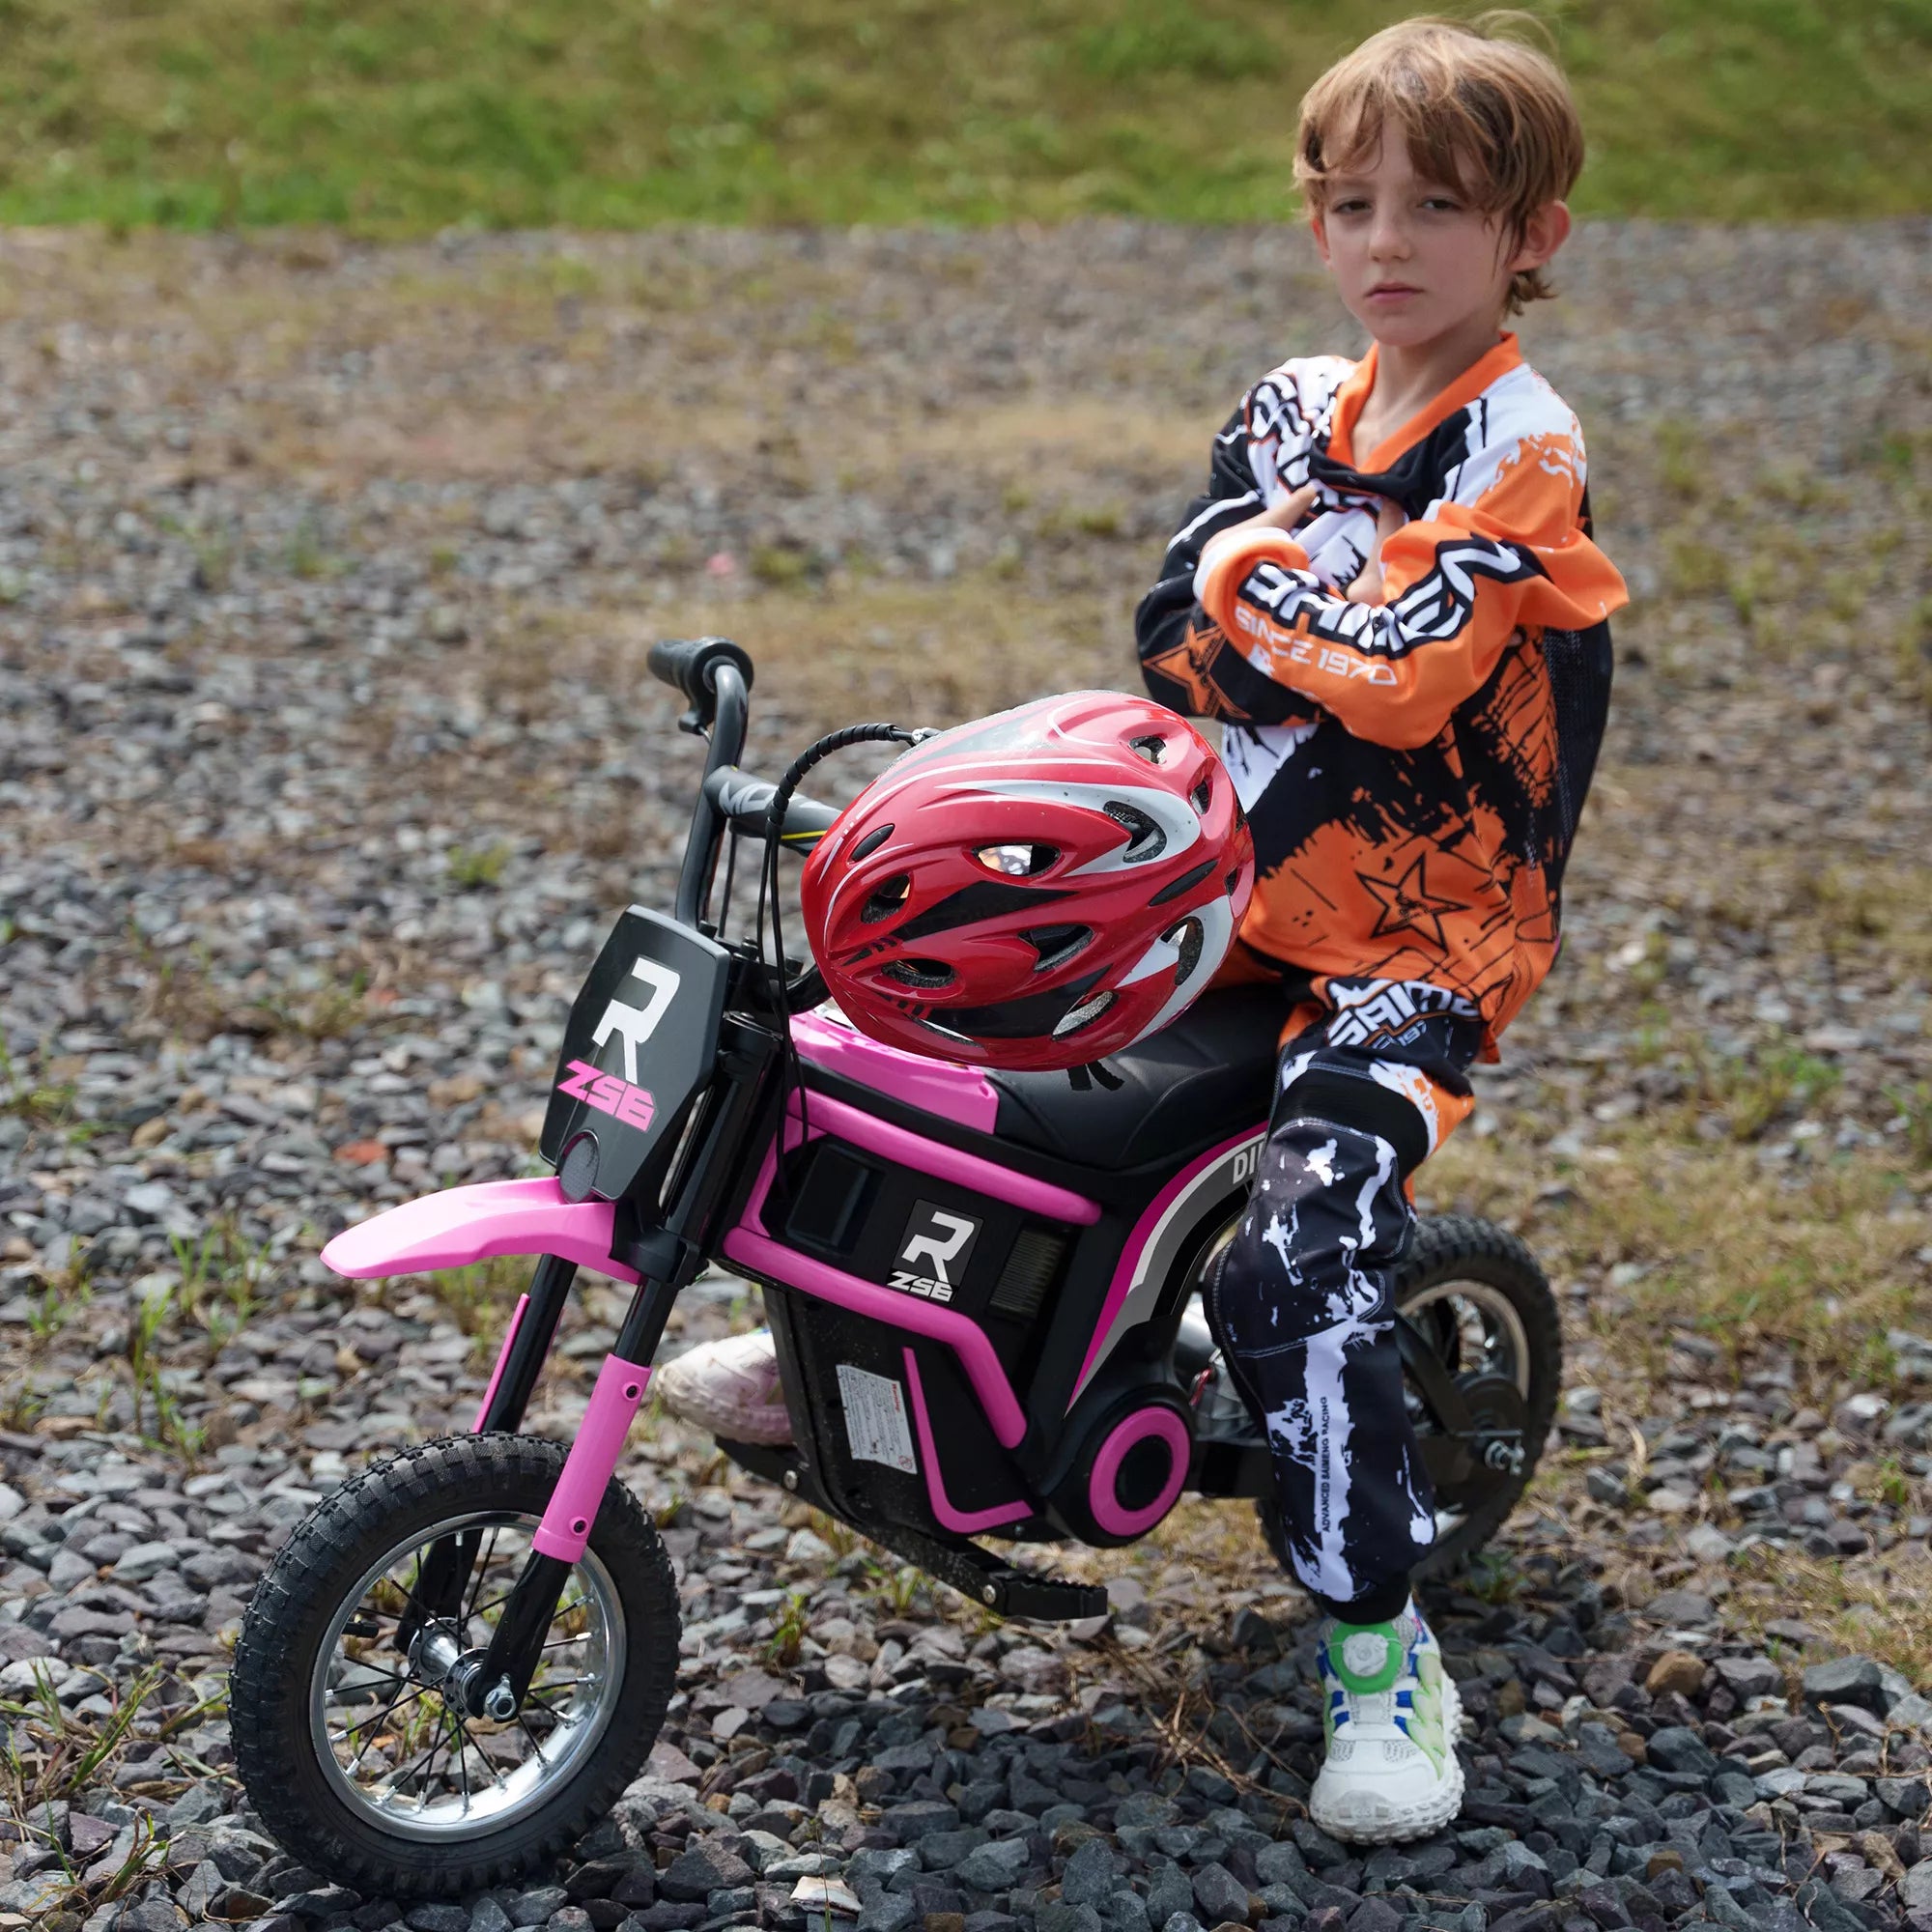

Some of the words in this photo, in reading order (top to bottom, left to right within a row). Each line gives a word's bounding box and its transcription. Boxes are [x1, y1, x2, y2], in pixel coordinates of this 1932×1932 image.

[1234, 605, 1314, 666] SINCE
[1317, 648, 1399, 686] 1970
[591, 956, 681, 1085] R
[556, 1058, 656, 1133] ZS6
[901, 1210, 976, 1285] R
[886, 1270, 953, 1303] ZS6
[1320, 1396, 1329, 1435] RACING
[1321, 1481, 1331, 1533] ADVANCED
